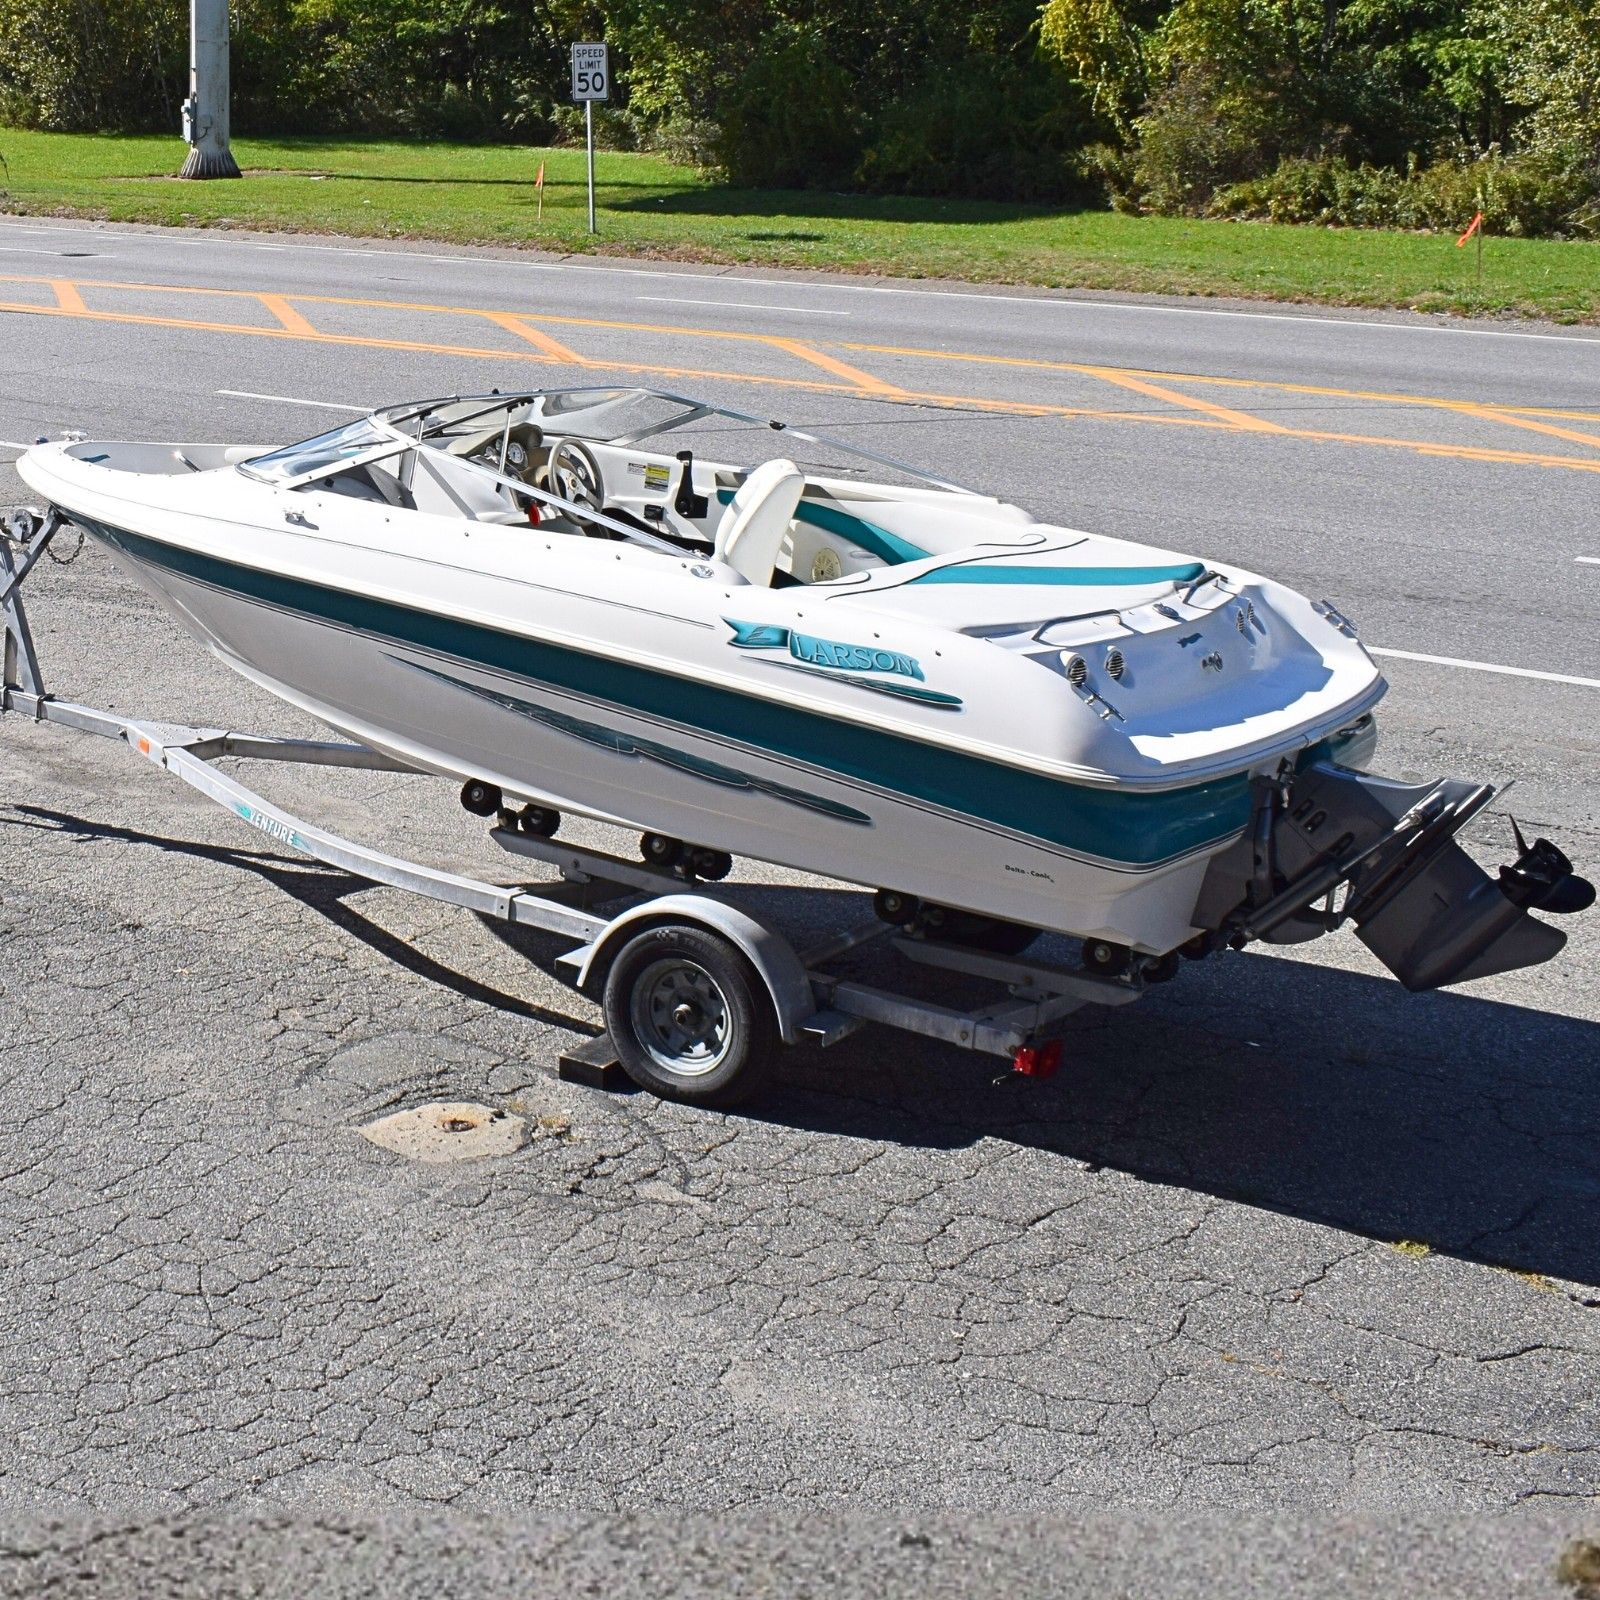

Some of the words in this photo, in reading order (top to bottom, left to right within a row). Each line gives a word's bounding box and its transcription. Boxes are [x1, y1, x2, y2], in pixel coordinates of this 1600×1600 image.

[576, 49, 604, 58] SPEED
[579, 60, 602, 70] LIMIT
[577, 72, 604, 93] 50
[793, 635, 915, 676] LARSON
[249, 809, 296, 845] VENTURE
